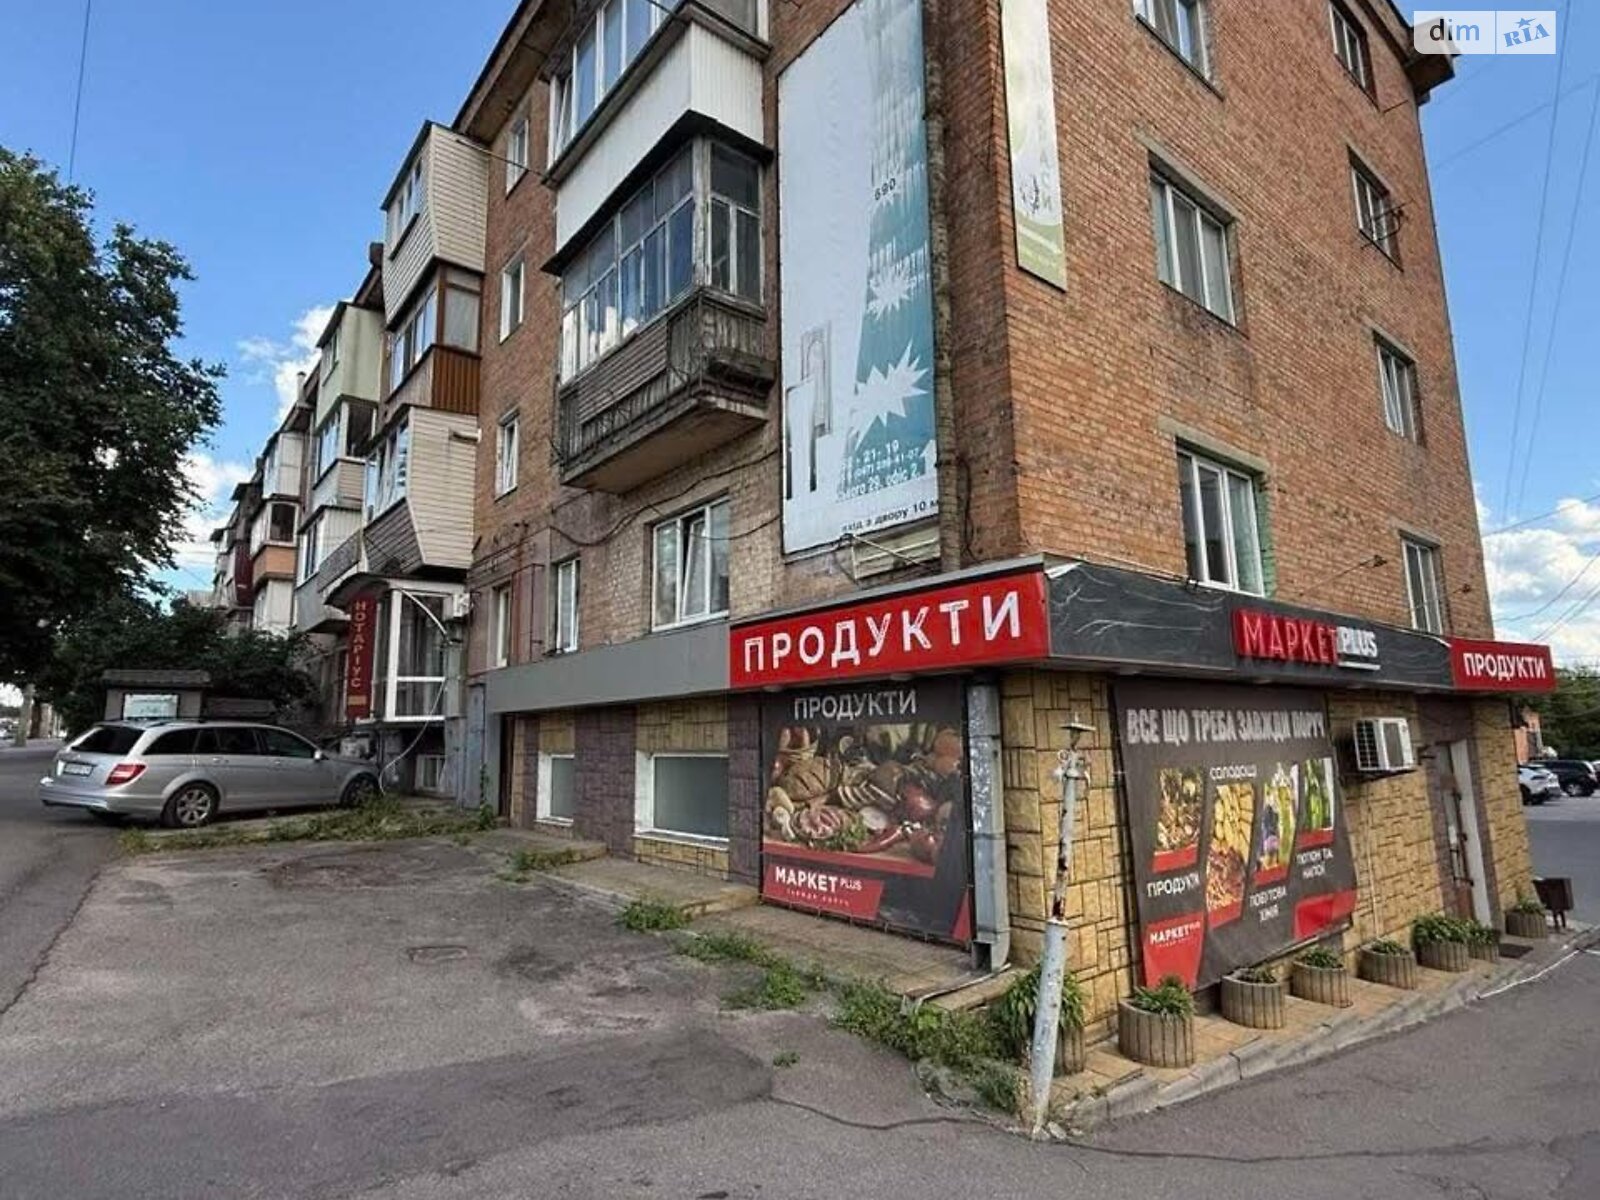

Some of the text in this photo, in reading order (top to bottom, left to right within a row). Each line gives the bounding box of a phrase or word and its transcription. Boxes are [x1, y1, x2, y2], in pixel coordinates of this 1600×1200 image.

[913, 500, 926, 513] 10
[350, 600, 367, 688] НОТАРІУС
[743, 591, 1021, 673] ПРОДУКТИ
[1238, 609, 1378, 666] МАРКЕТ PLUS
[1462, 652, 1546, 682] ПРОДУКТИ
[794, 689, 917, 722] ПРОДУКТИ
[1126, 708, 1161, 745] ВСЕ
[1162, 709, 1190, 747] ЩО
[1191, 710, 1237, 743] ТРЕБА
[775, 866, 837, 893] МАРКЕТ
[1149, 923, 1189, 946] МАРКЕТ
